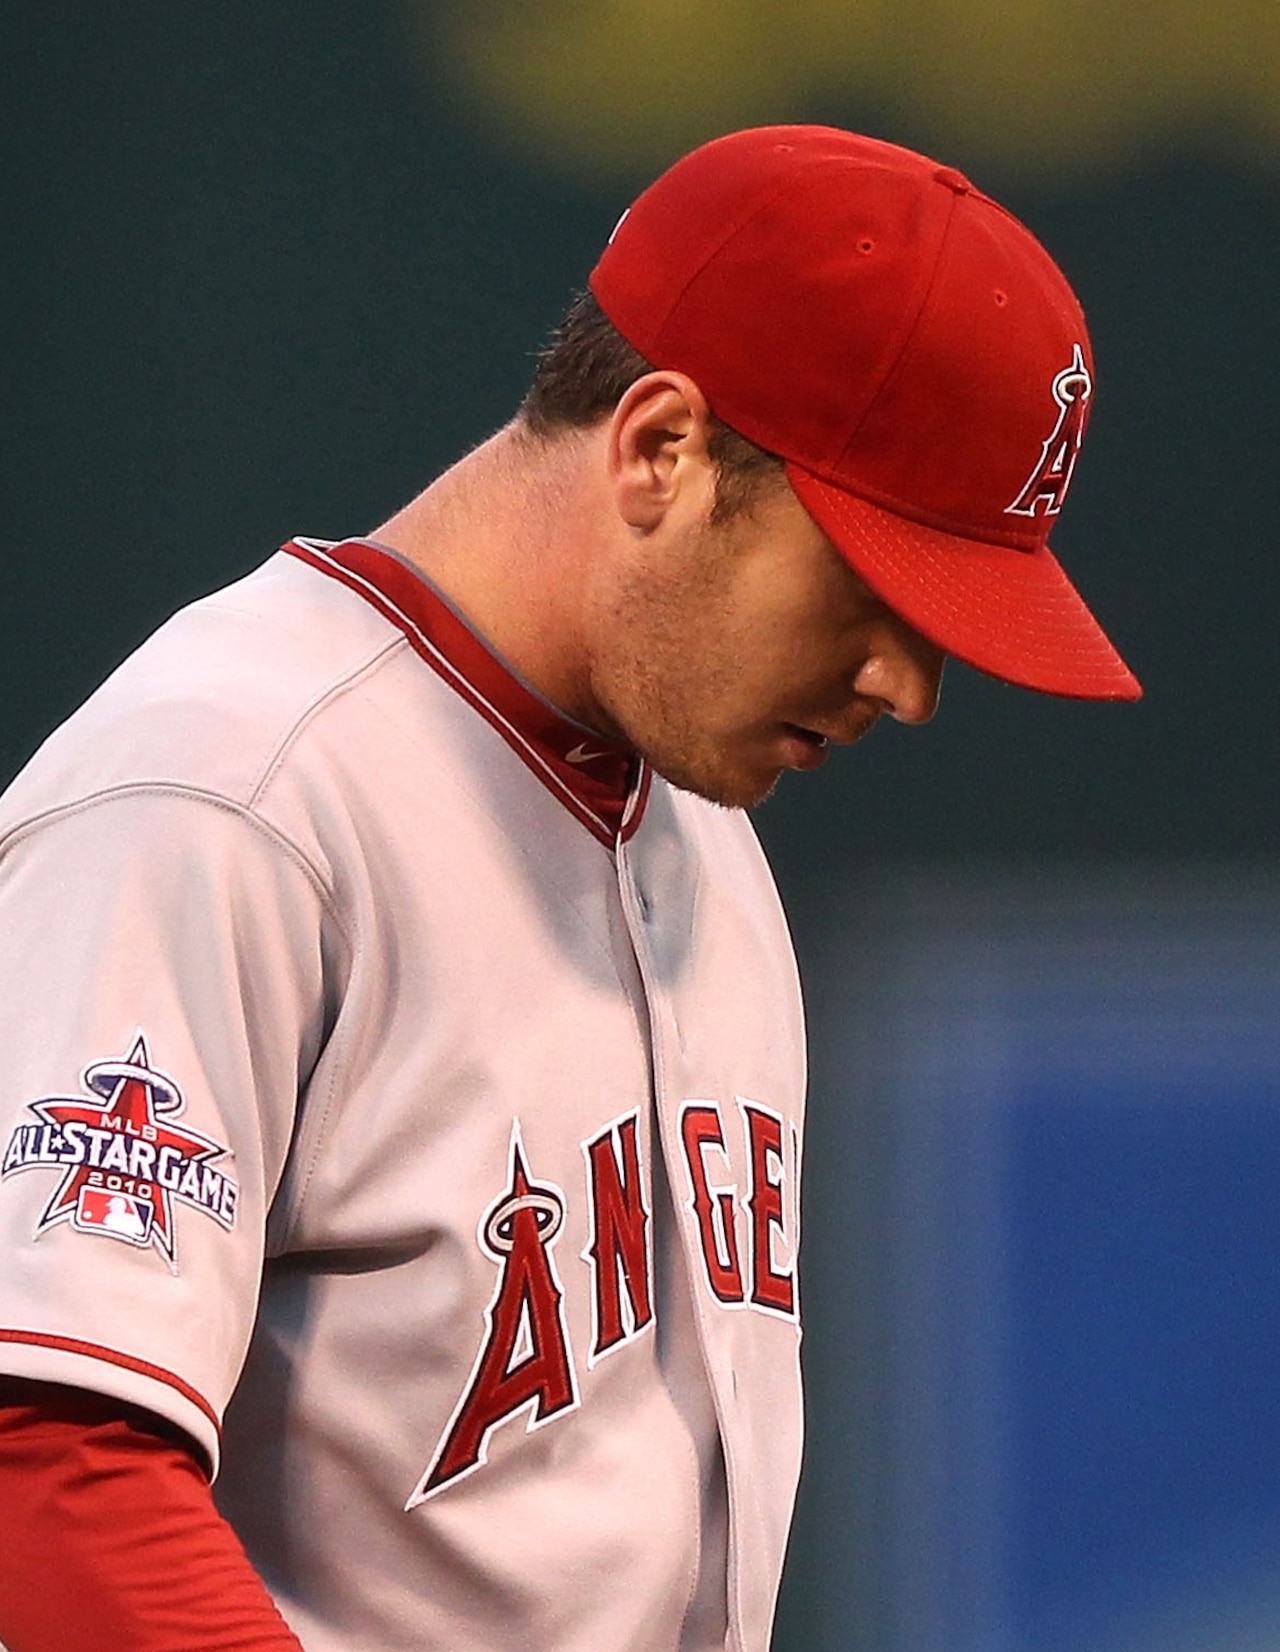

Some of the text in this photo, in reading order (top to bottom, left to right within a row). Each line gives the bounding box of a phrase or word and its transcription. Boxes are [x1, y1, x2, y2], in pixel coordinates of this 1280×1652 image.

[100, 1113, 159, 1142] MLB
[87, 1171, 153, 1199] 2010
[404, 1095, 800, 1512] ANGE
